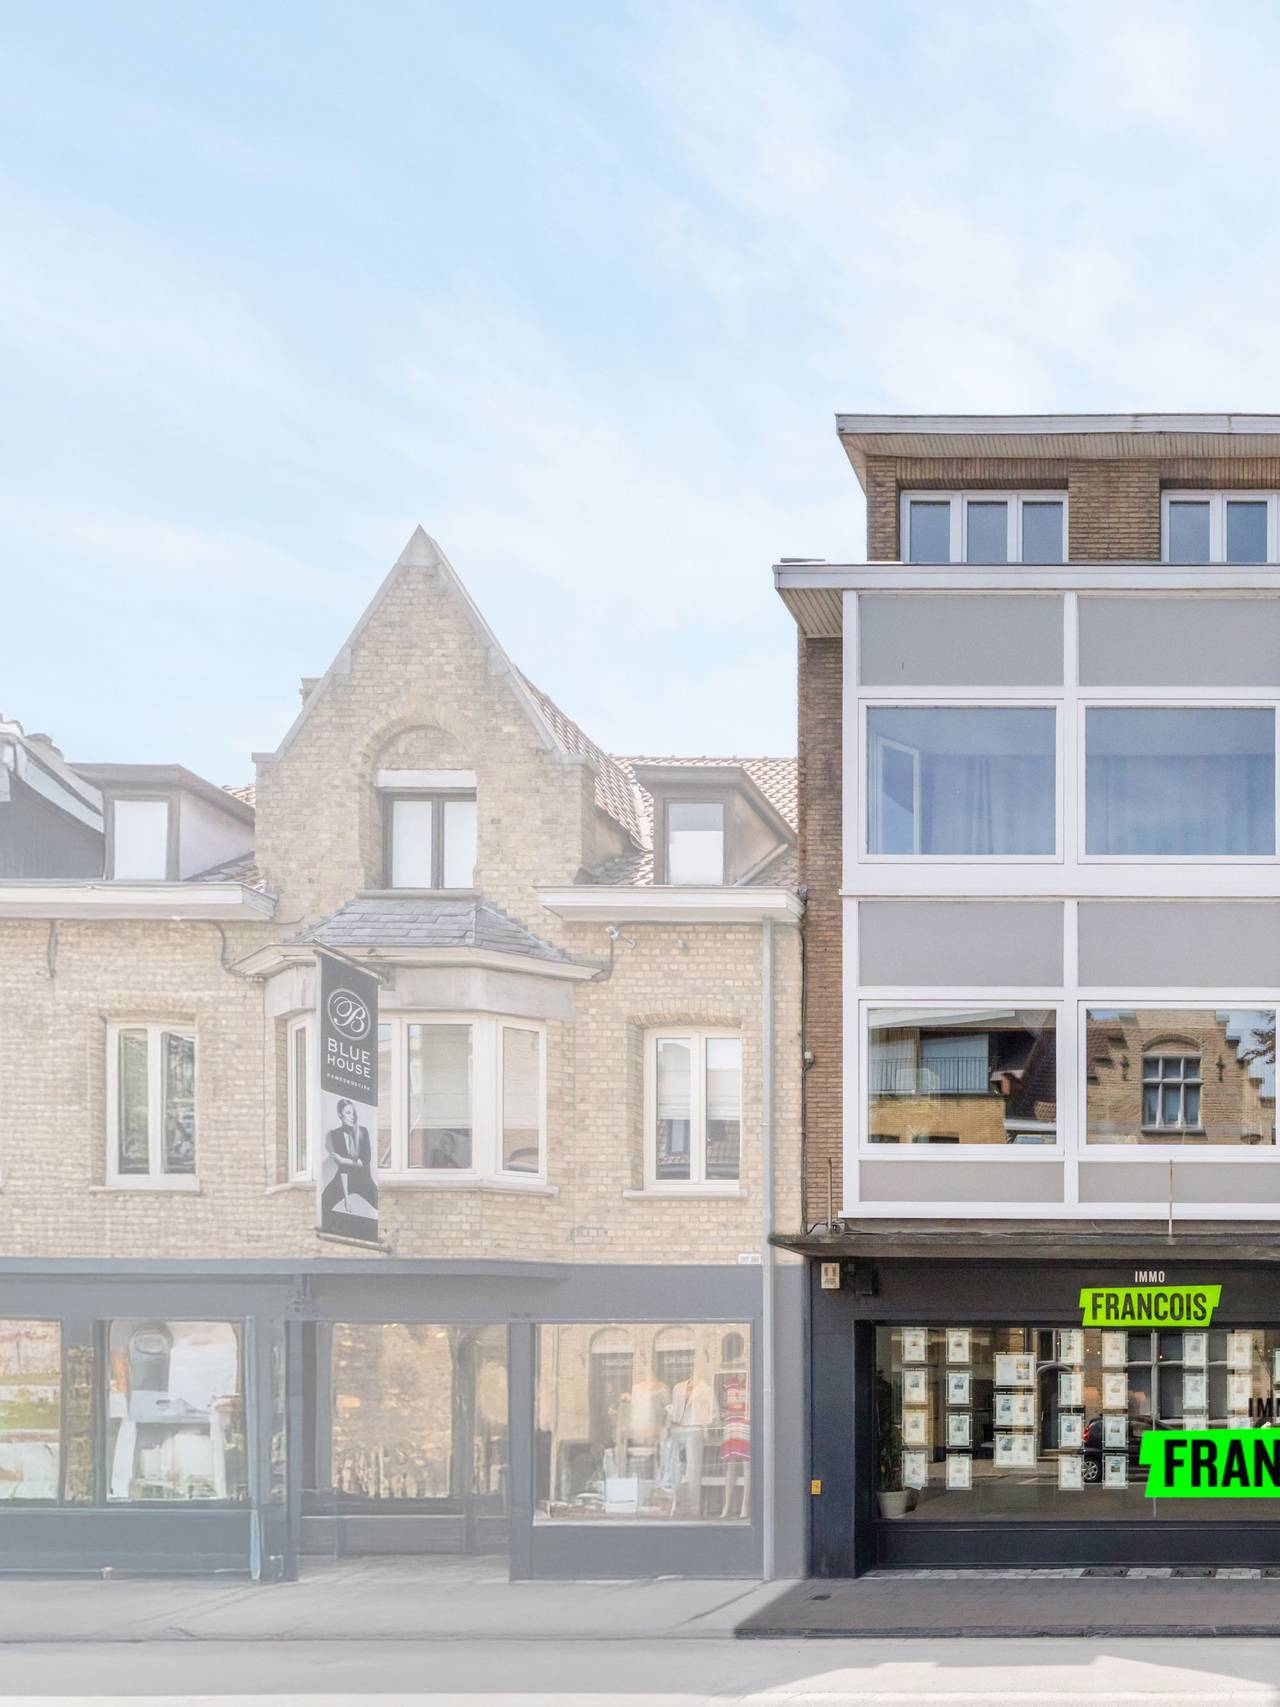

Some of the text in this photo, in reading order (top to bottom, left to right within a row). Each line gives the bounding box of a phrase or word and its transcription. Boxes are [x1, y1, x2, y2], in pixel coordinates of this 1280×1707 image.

[327, 1037, 370, 1065] BLUE
[327, 1053, 370, 1078] HOUSE
[1135, 1271, 1165, 1283] IMMO
[1091, 1292, 1207, 1321] FRANCOIS
